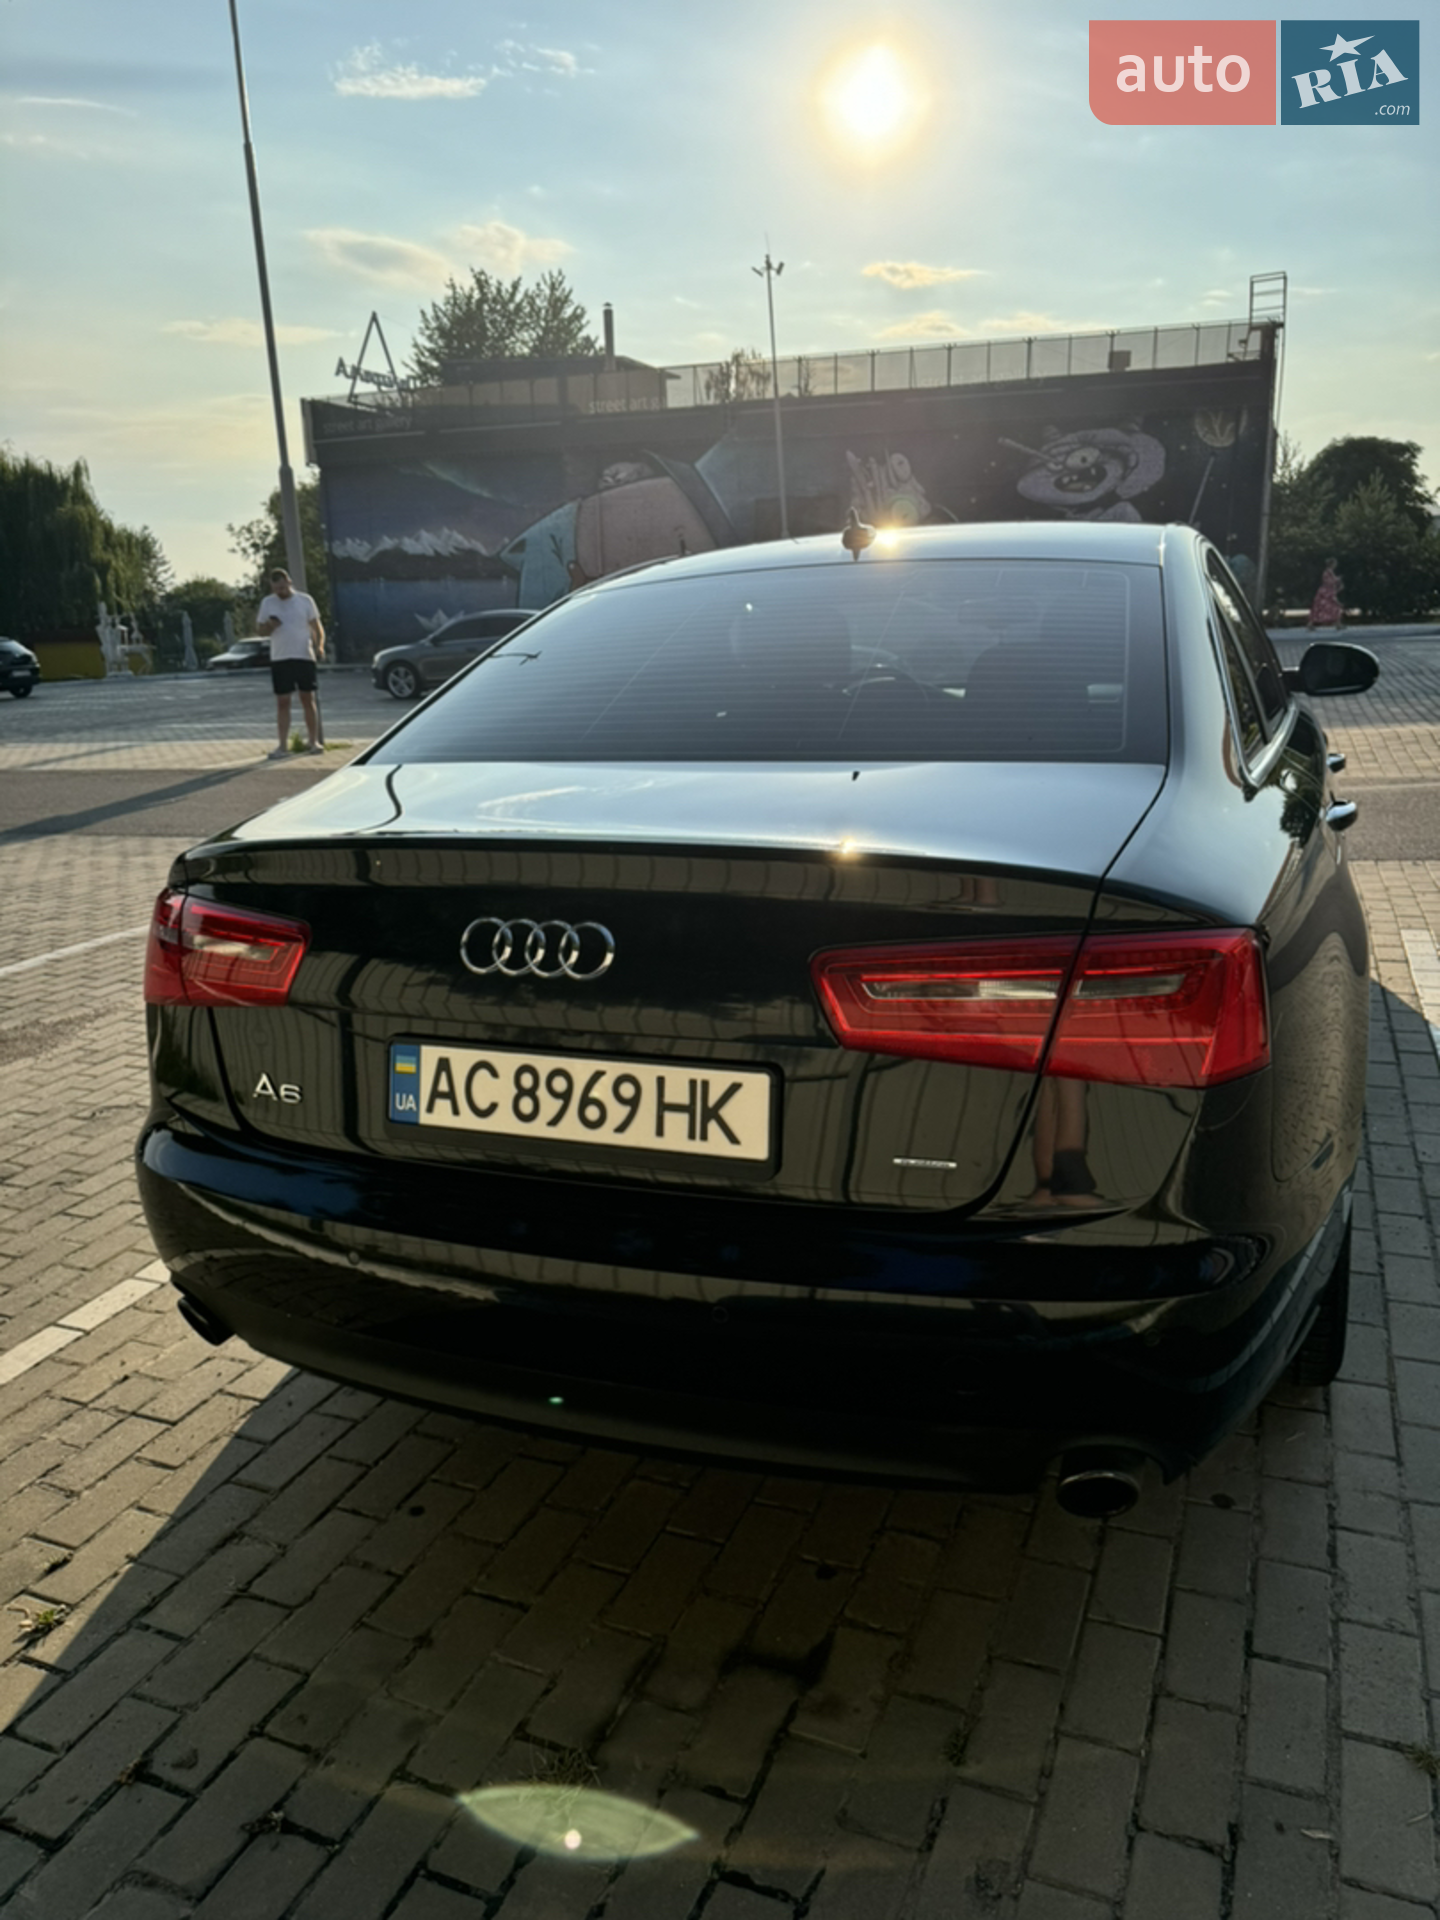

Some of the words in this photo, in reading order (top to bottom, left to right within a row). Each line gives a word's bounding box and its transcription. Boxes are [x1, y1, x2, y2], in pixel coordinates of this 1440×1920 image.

[588, 399, 626, 414] street
[629, 397, 648, 411] art
[252, 1072, 301, 1104] A6
[395, 1094, 417, 1112] UA
[425, 1056, 500, 1119] AC
[511, 1064, 642, 1135] 8969
[655, 1076, 743, 1146] HK
